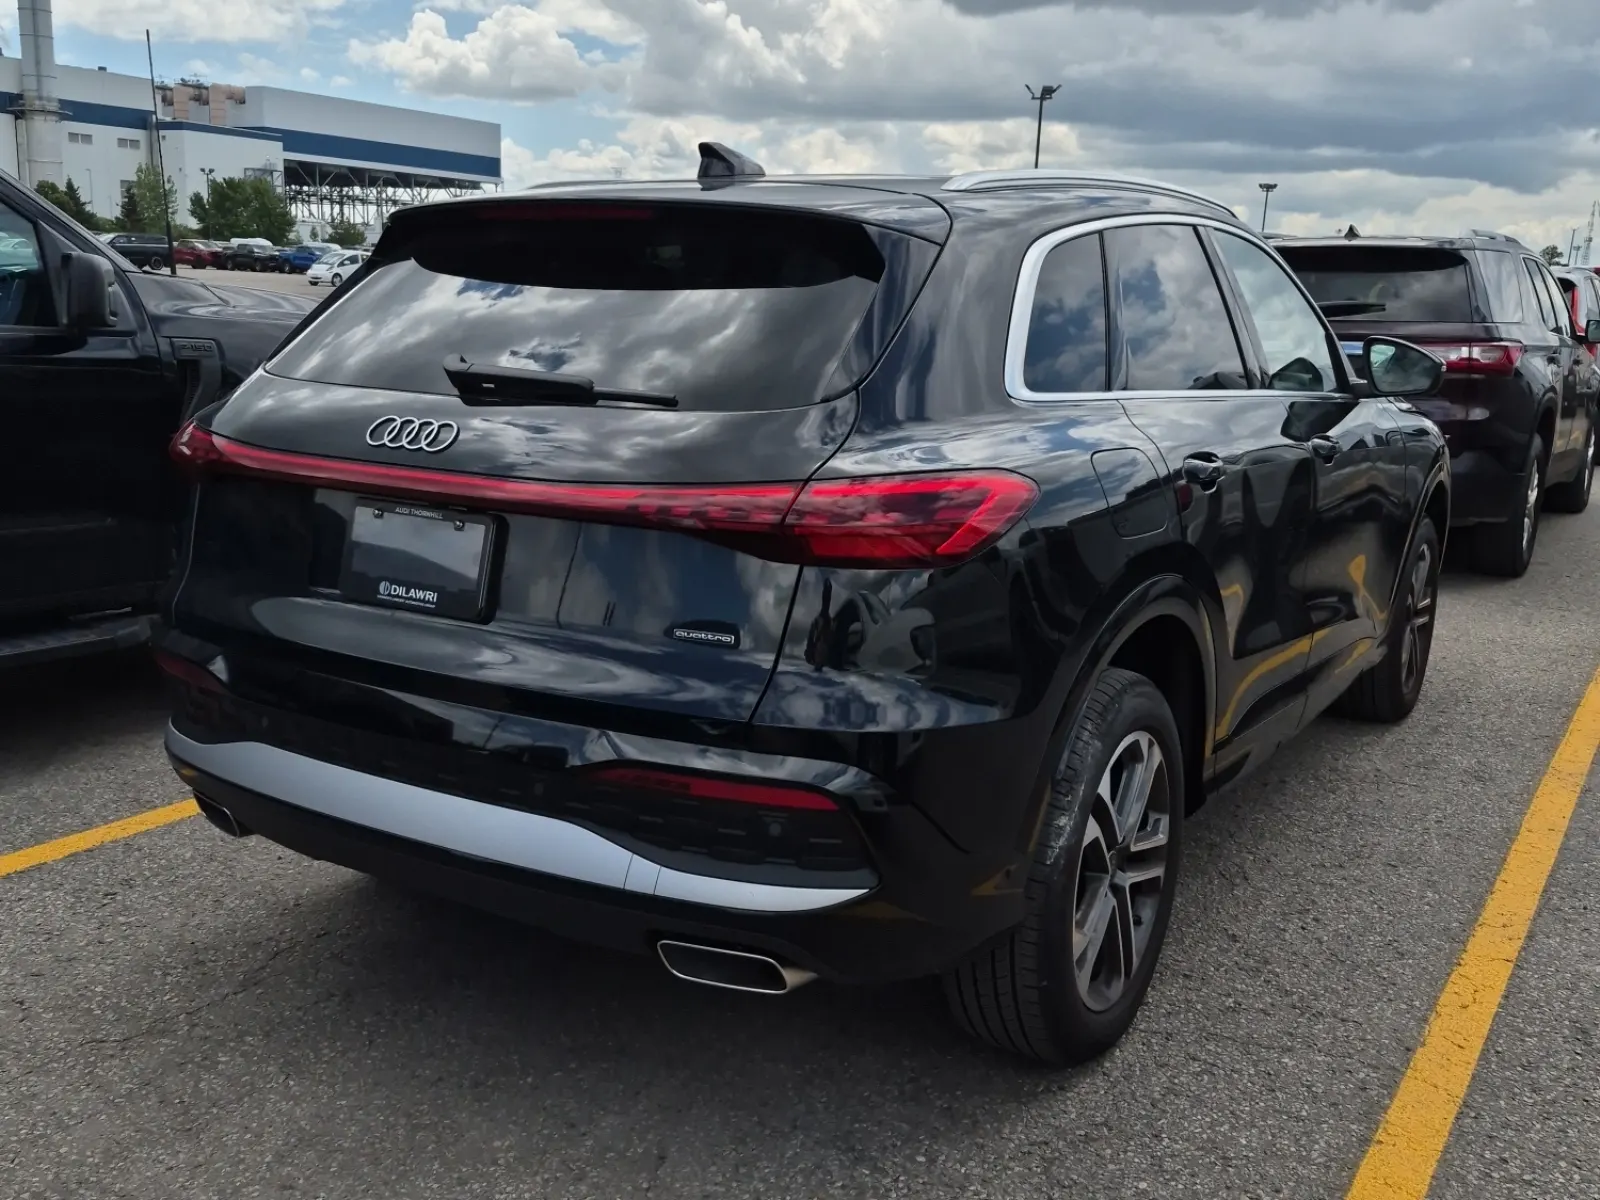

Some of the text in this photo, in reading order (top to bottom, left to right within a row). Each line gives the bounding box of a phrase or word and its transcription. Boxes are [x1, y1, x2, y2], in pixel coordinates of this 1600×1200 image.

[411, 508, 443, 519] THORNHILL
[391, 584, 438, 602] DILAWRI
[675, 631, 732, 642] quattro
